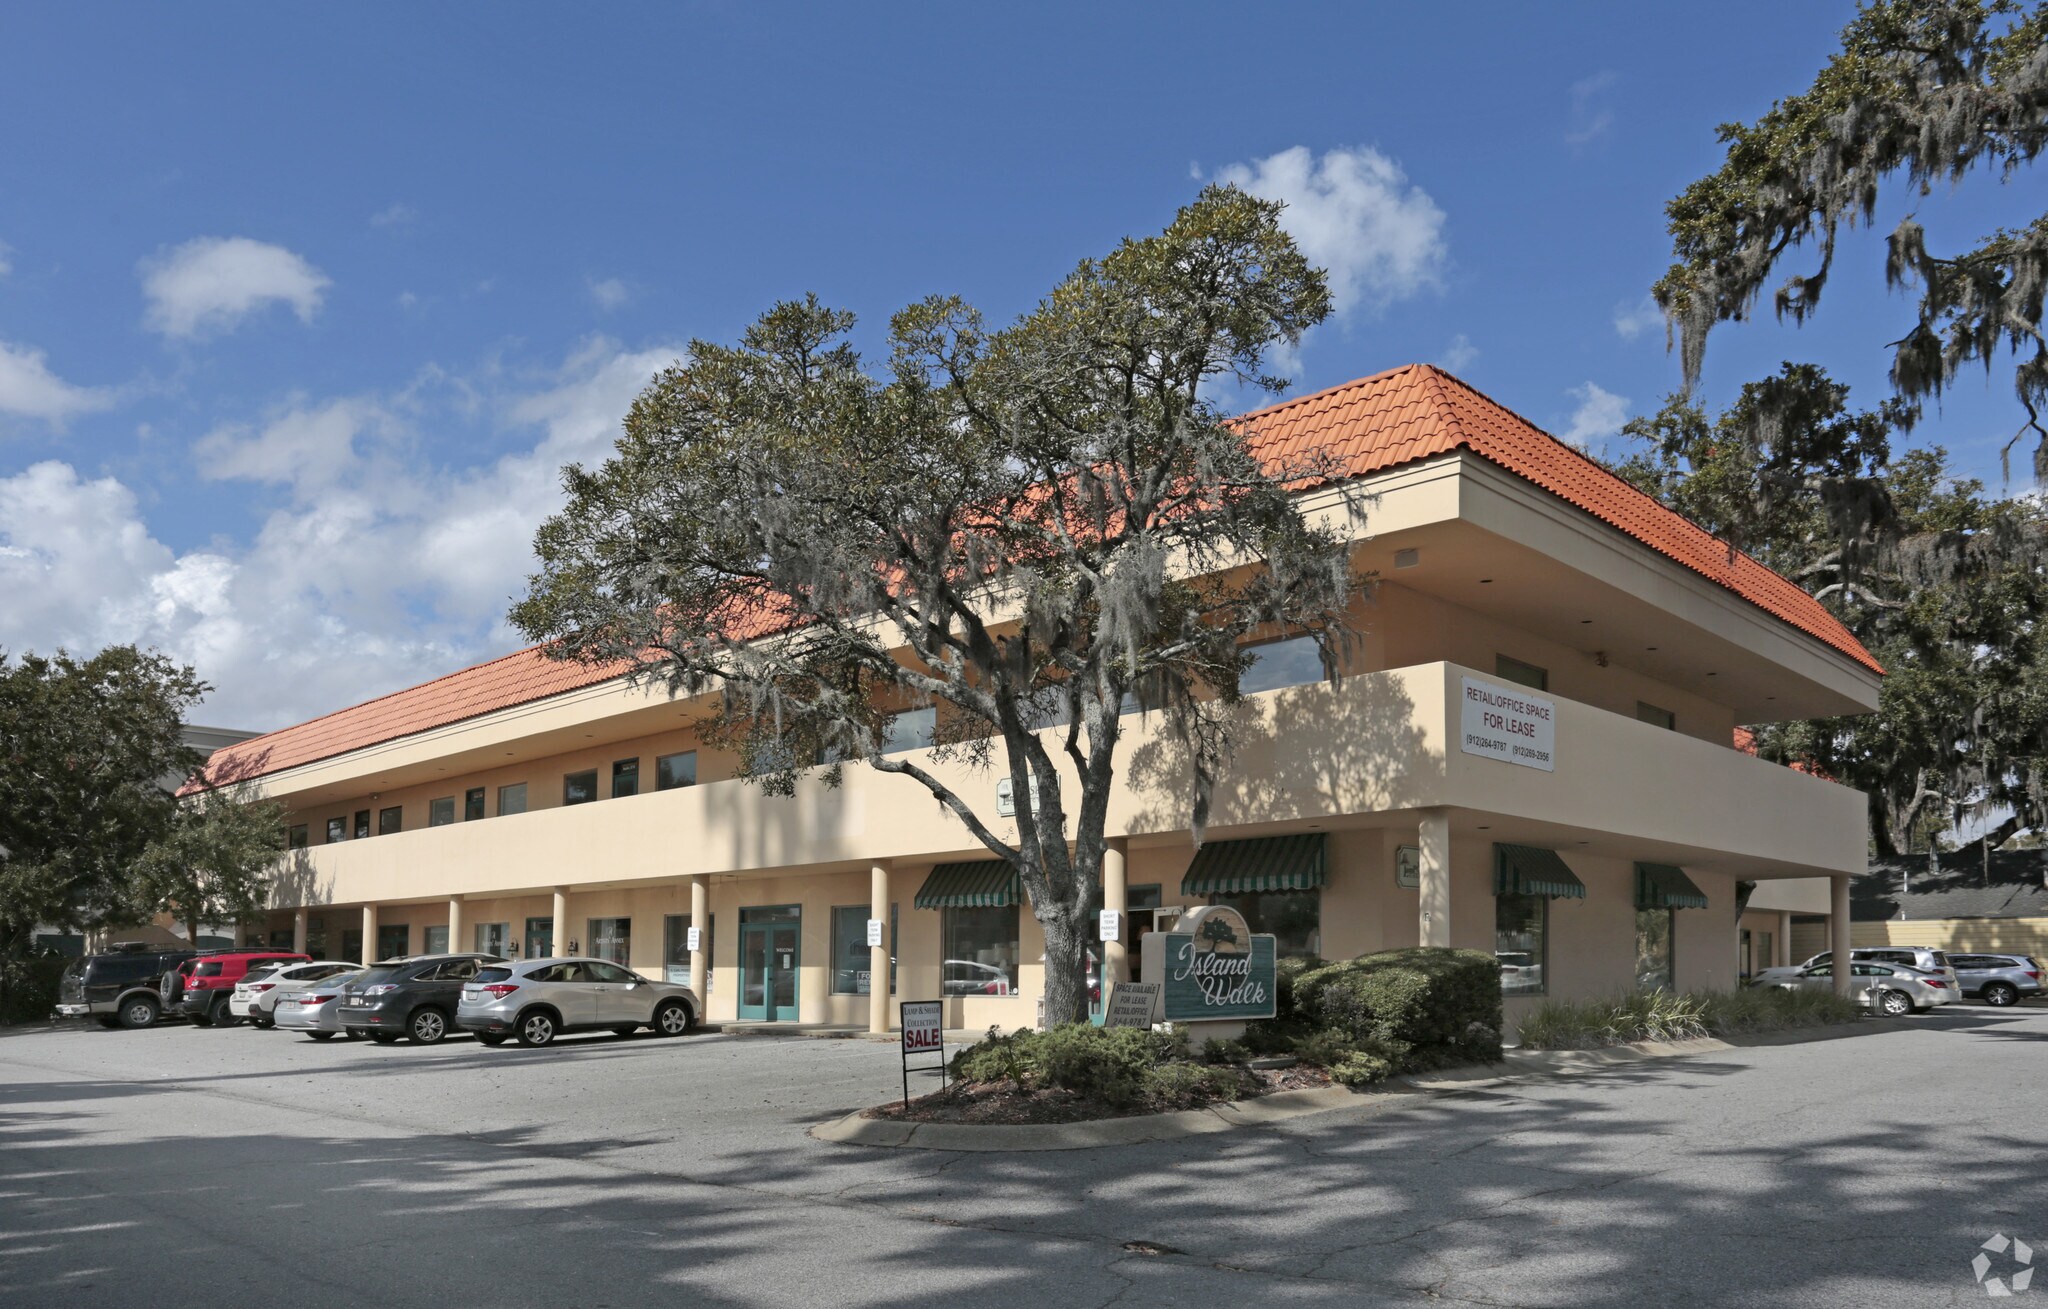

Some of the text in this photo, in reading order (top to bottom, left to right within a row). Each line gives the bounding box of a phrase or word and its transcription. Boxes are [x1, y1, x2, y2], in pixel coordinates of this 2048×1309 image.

[1467, 687, 1550, 721] RETAIL/OFFICE SPACE
[1484, 712, 1535, 738] FOR LEASE
[1467, 734, 1507, 751] (912)264-9787
[1174, 943, 1252, 981] Island
[1116, 984, 1156, 994] SPACE AVAILABLE
[1201, 976, 1267, 1006] Walk
[1120, 996, 1147, 1004] FOR LEASE
[919, 1006, 924, 1014] &
[1113, 1007, 1148, 1015] RETAIL/OFFICE
[907, 1019, 938, 1028] COLLECTION
